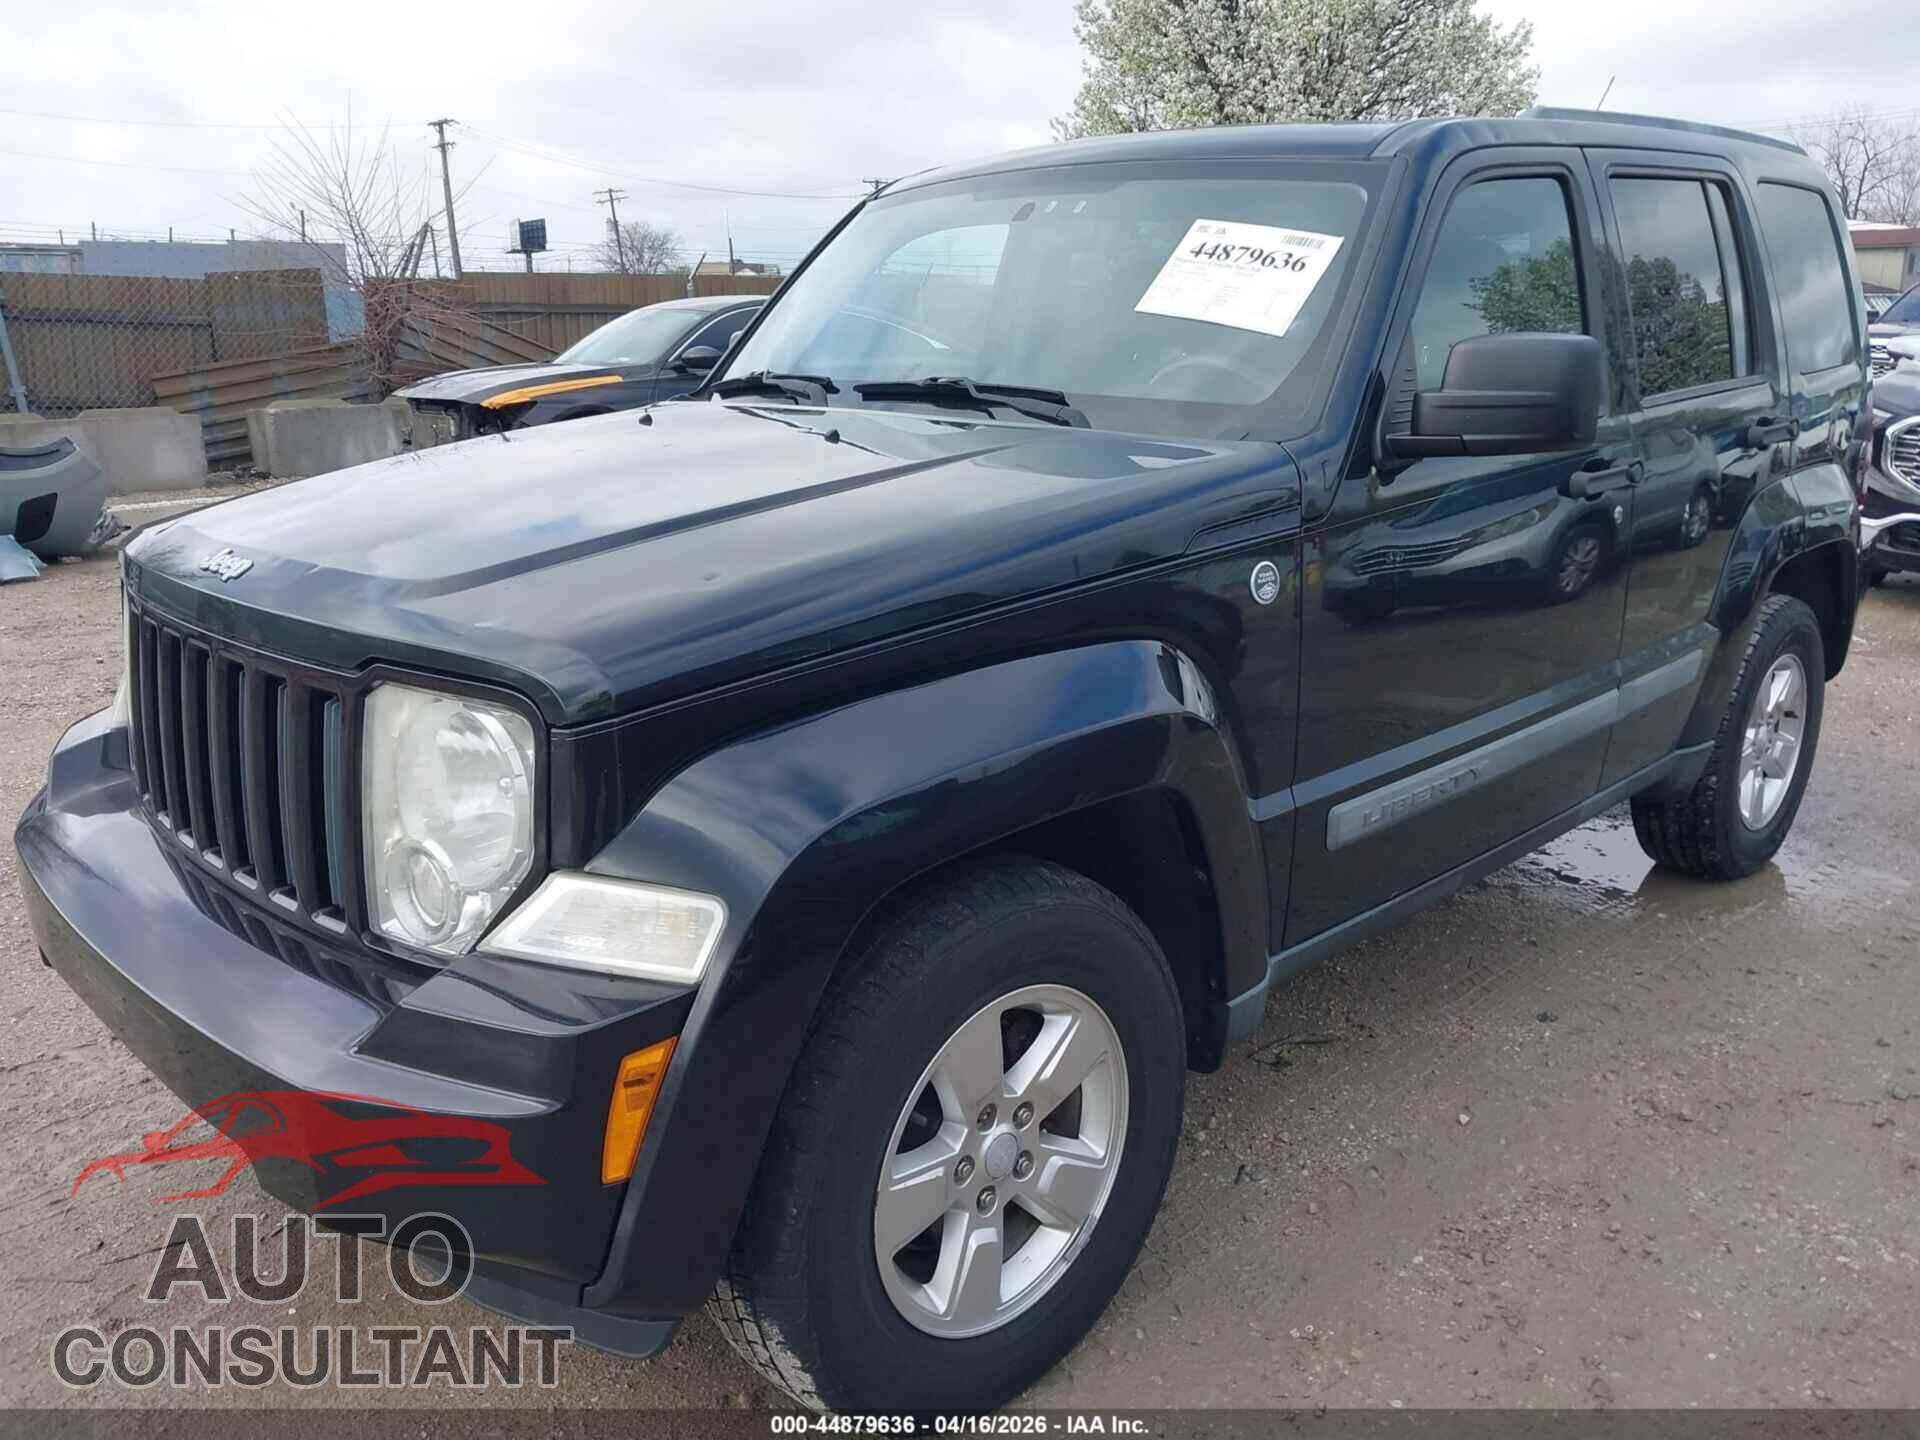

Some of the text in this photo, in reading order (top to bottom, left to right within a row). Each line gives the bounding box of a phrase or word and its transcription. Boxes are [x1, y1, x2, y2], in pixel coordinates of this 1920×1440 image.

[1189, 241, 1311, 272] 44879636
[200, 547, 253, 582] Jeep
[1361, 761, 1488, 828] LIBERTY
